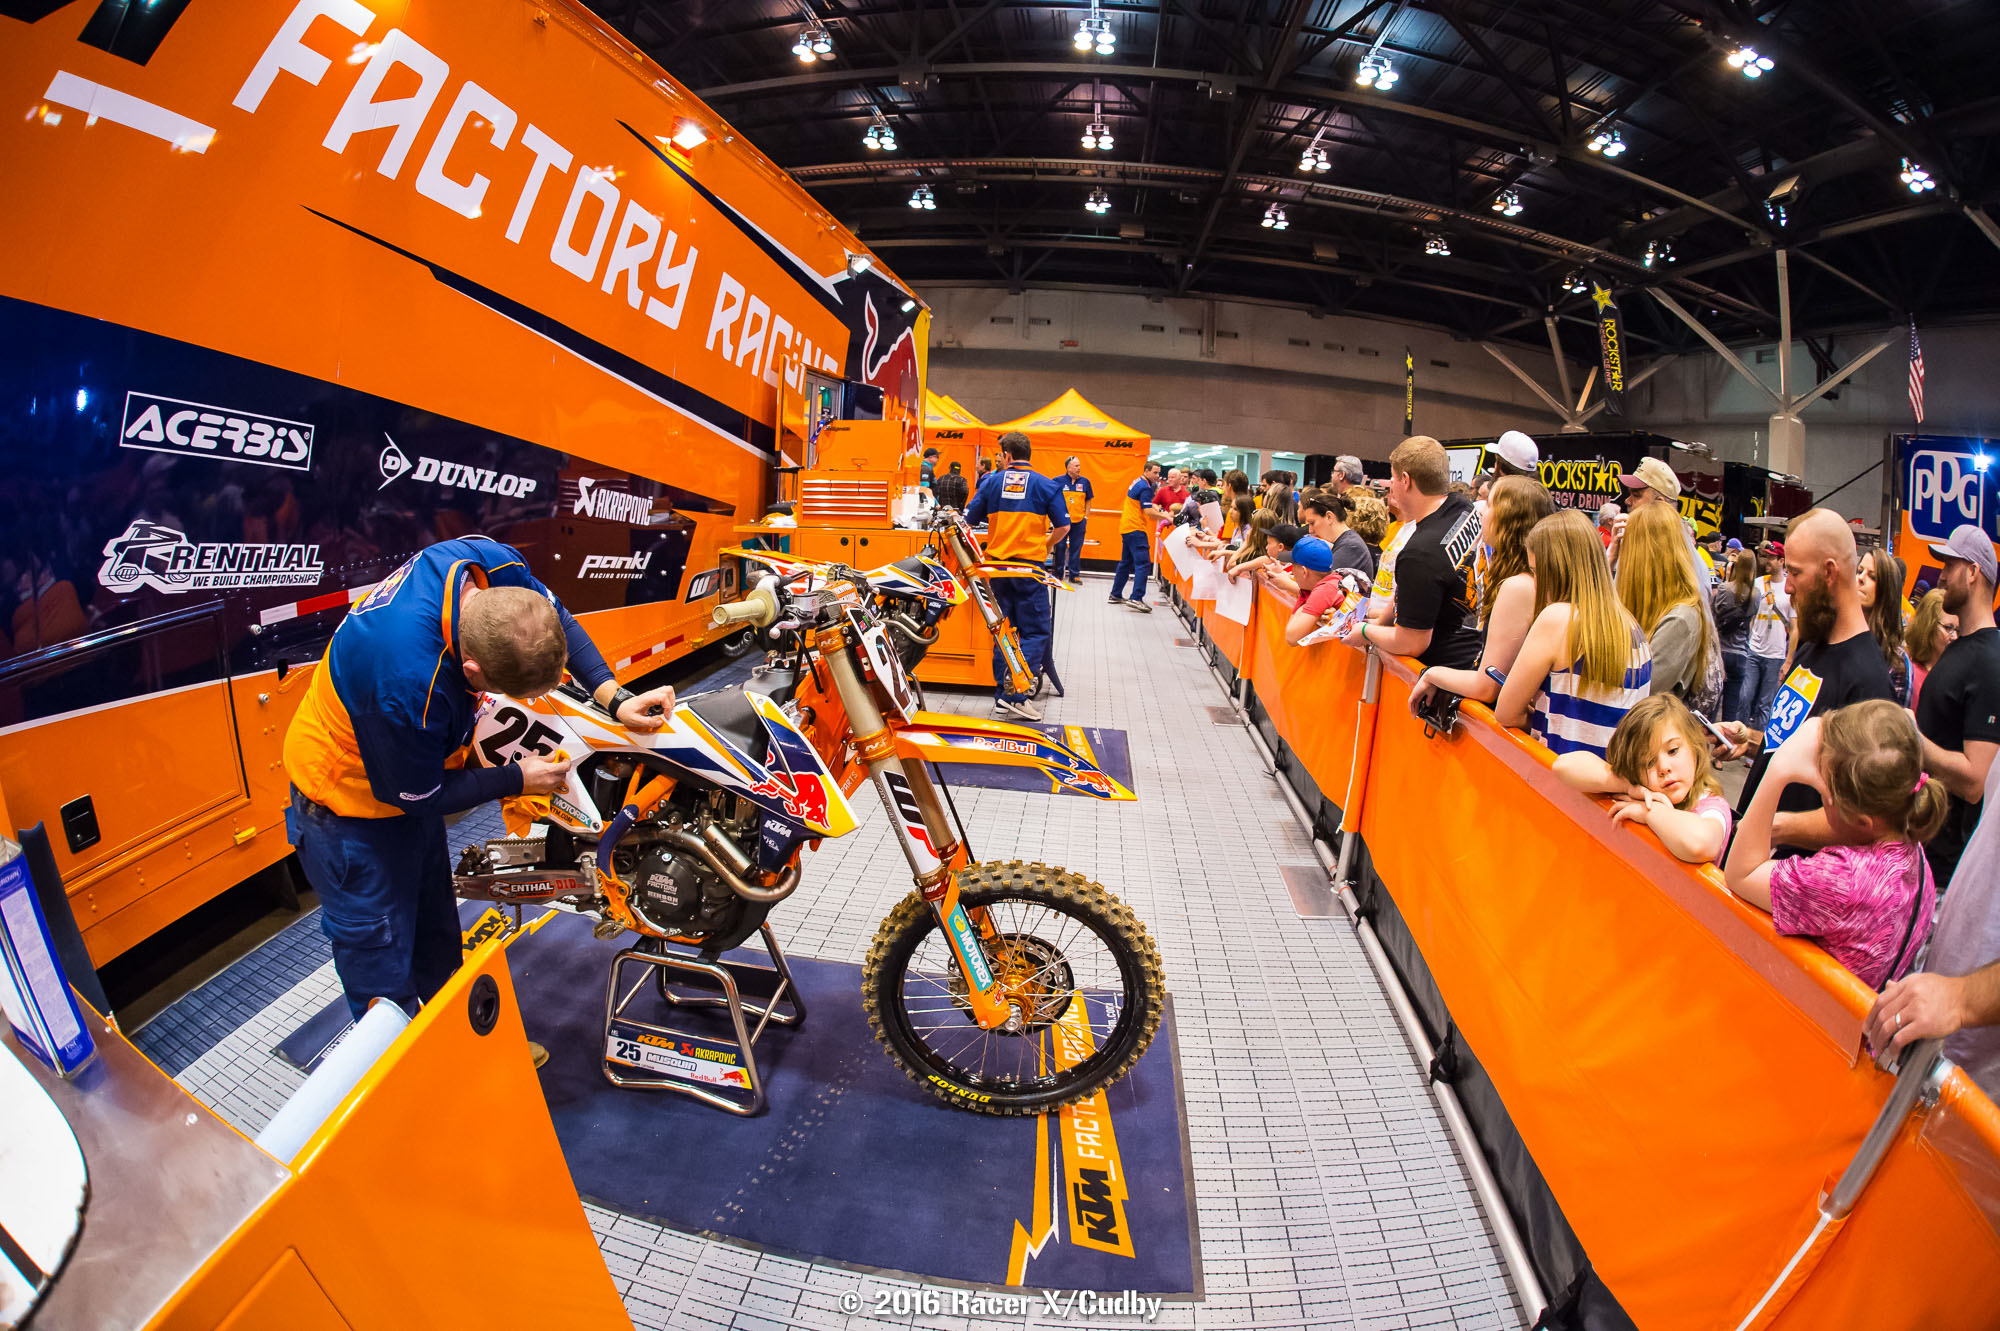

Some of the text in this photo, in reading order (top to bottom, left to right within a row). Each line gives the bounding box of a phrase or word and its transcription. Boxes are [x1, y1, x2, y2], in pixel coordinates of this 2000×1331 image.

[232, 0, 700, 330] FACTORY
[125, 404, 309, 462] ACERBIS
[936, 430, 964, 439] KTM
[1104, 440, 1134, 448] KTM
[411, 456, 537, 499] DUNLOP
[1448, 509, 1482, 567] DUNGE
[167, 542, 325, 572] RENTHAL
[193, 573, 319, 587] WE BUILD CHAMPIONSHIPS
[479, 706, 565, 768] 25
[1006, 741, 1036, 755] Bull
[764, 820, 792, 838] KTM
[959, 928, 992, 989] MOTOREX
[616, 1041, 642, 1062] 25
[637, 1034, 676, 1050] KTM
[927, 1074, 992, 1104] DUNLOP
[1073, 1168, 1120, 1246] KTM
